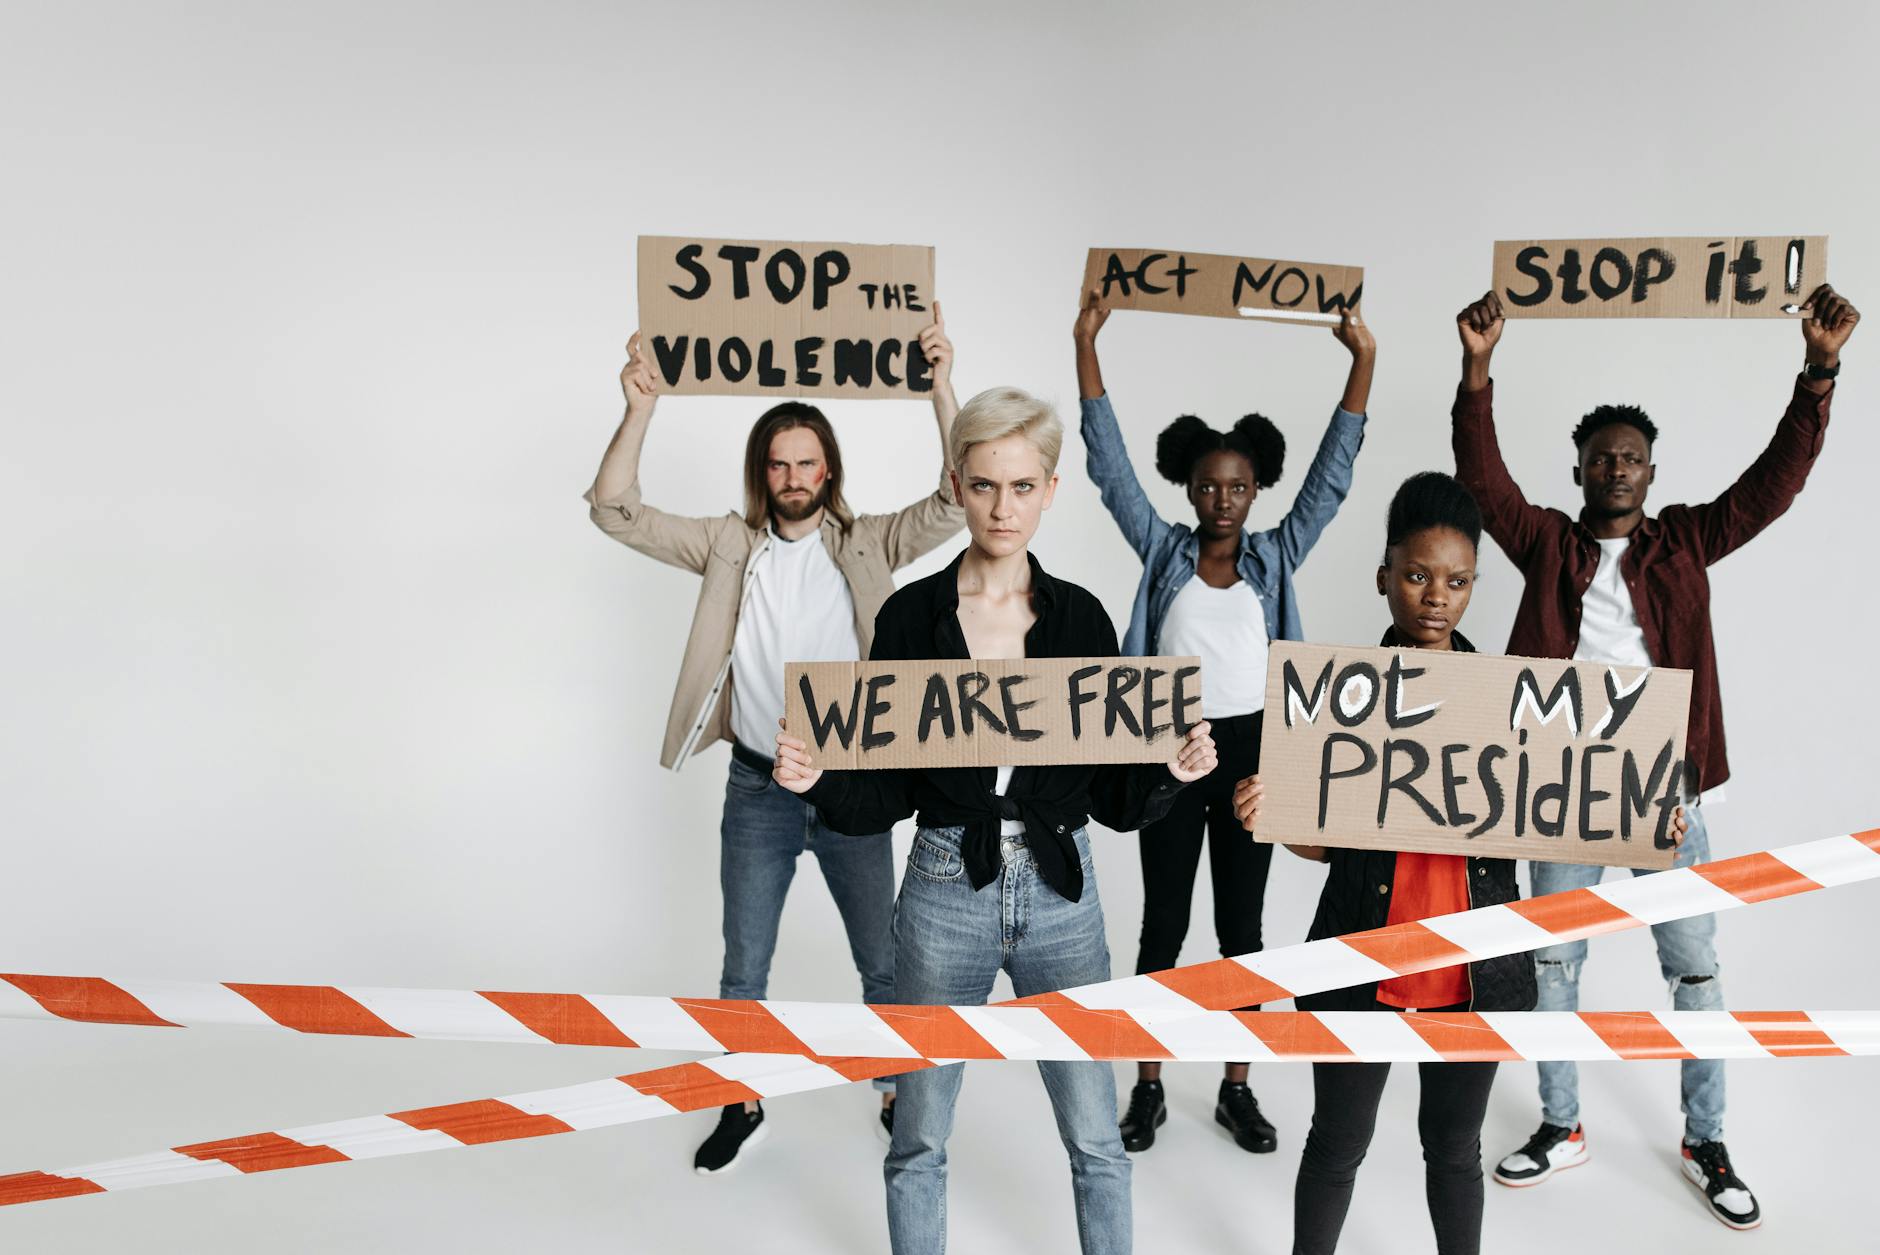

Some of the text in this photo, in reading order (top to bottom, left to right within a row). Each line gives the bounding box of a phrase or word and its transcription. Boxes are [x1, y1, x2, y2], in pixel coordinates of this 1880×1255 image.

[668, 244, 926, 312] STOP THE
[1232, 260, 1363, 314] NOW
[652, 335, 934, 392] VIOLENCE
[799, 665, 1201, 751] WE ARE FREE
[1509, 665, 1654, 740] MY
